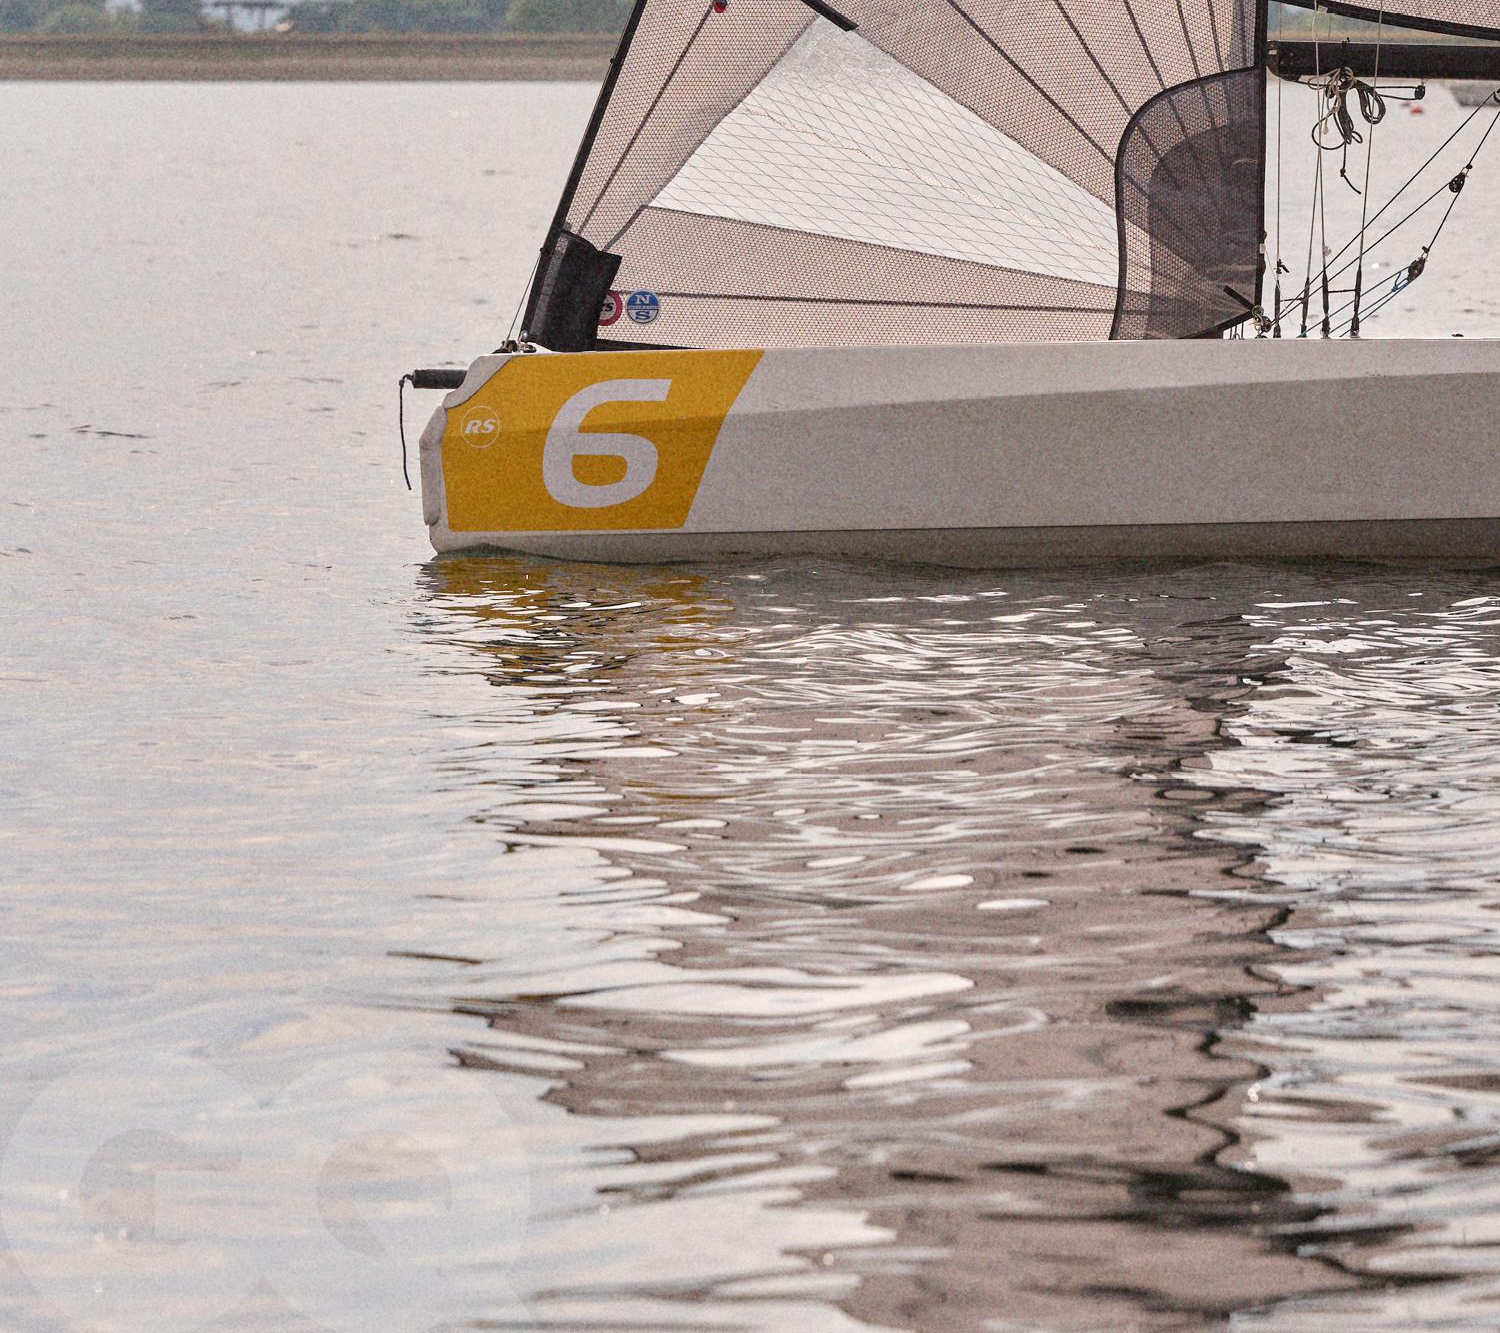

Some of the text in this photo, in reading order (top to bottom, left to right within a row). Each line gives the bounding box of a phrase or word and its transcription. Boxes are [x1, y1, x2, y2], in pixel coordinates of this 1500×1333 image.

[635, 294, 651, 304] N
[635, 311, 651, 320] S
[464, 419, 496, 434] RS
[542, 378, 673, 509] 6
